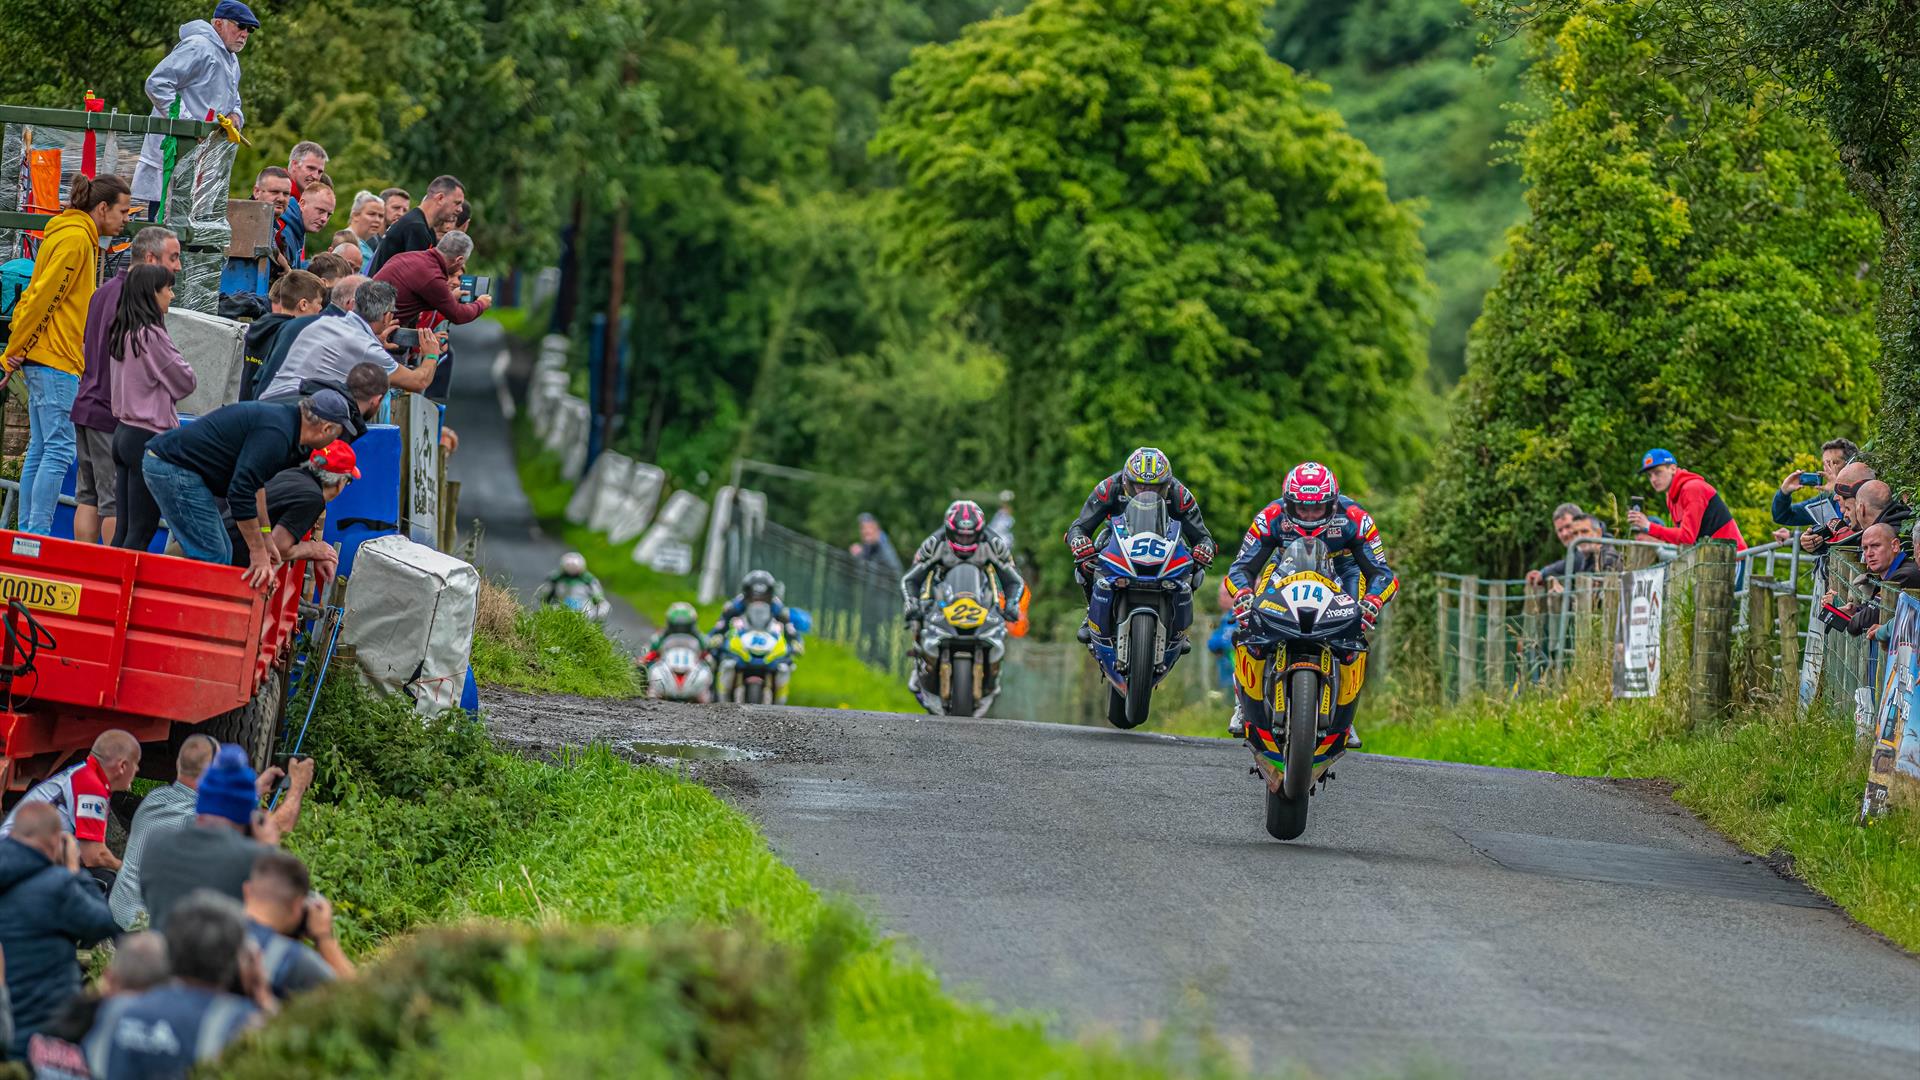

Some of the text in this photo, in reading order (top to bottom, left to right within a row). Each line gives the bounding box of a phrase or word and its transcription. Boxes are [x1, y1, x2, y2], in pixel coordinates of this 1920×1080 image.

[1130, 538, 1166, 558] 56
[1292, 584, 1324, 602] 174
[950, 604, 981, 621] 22
